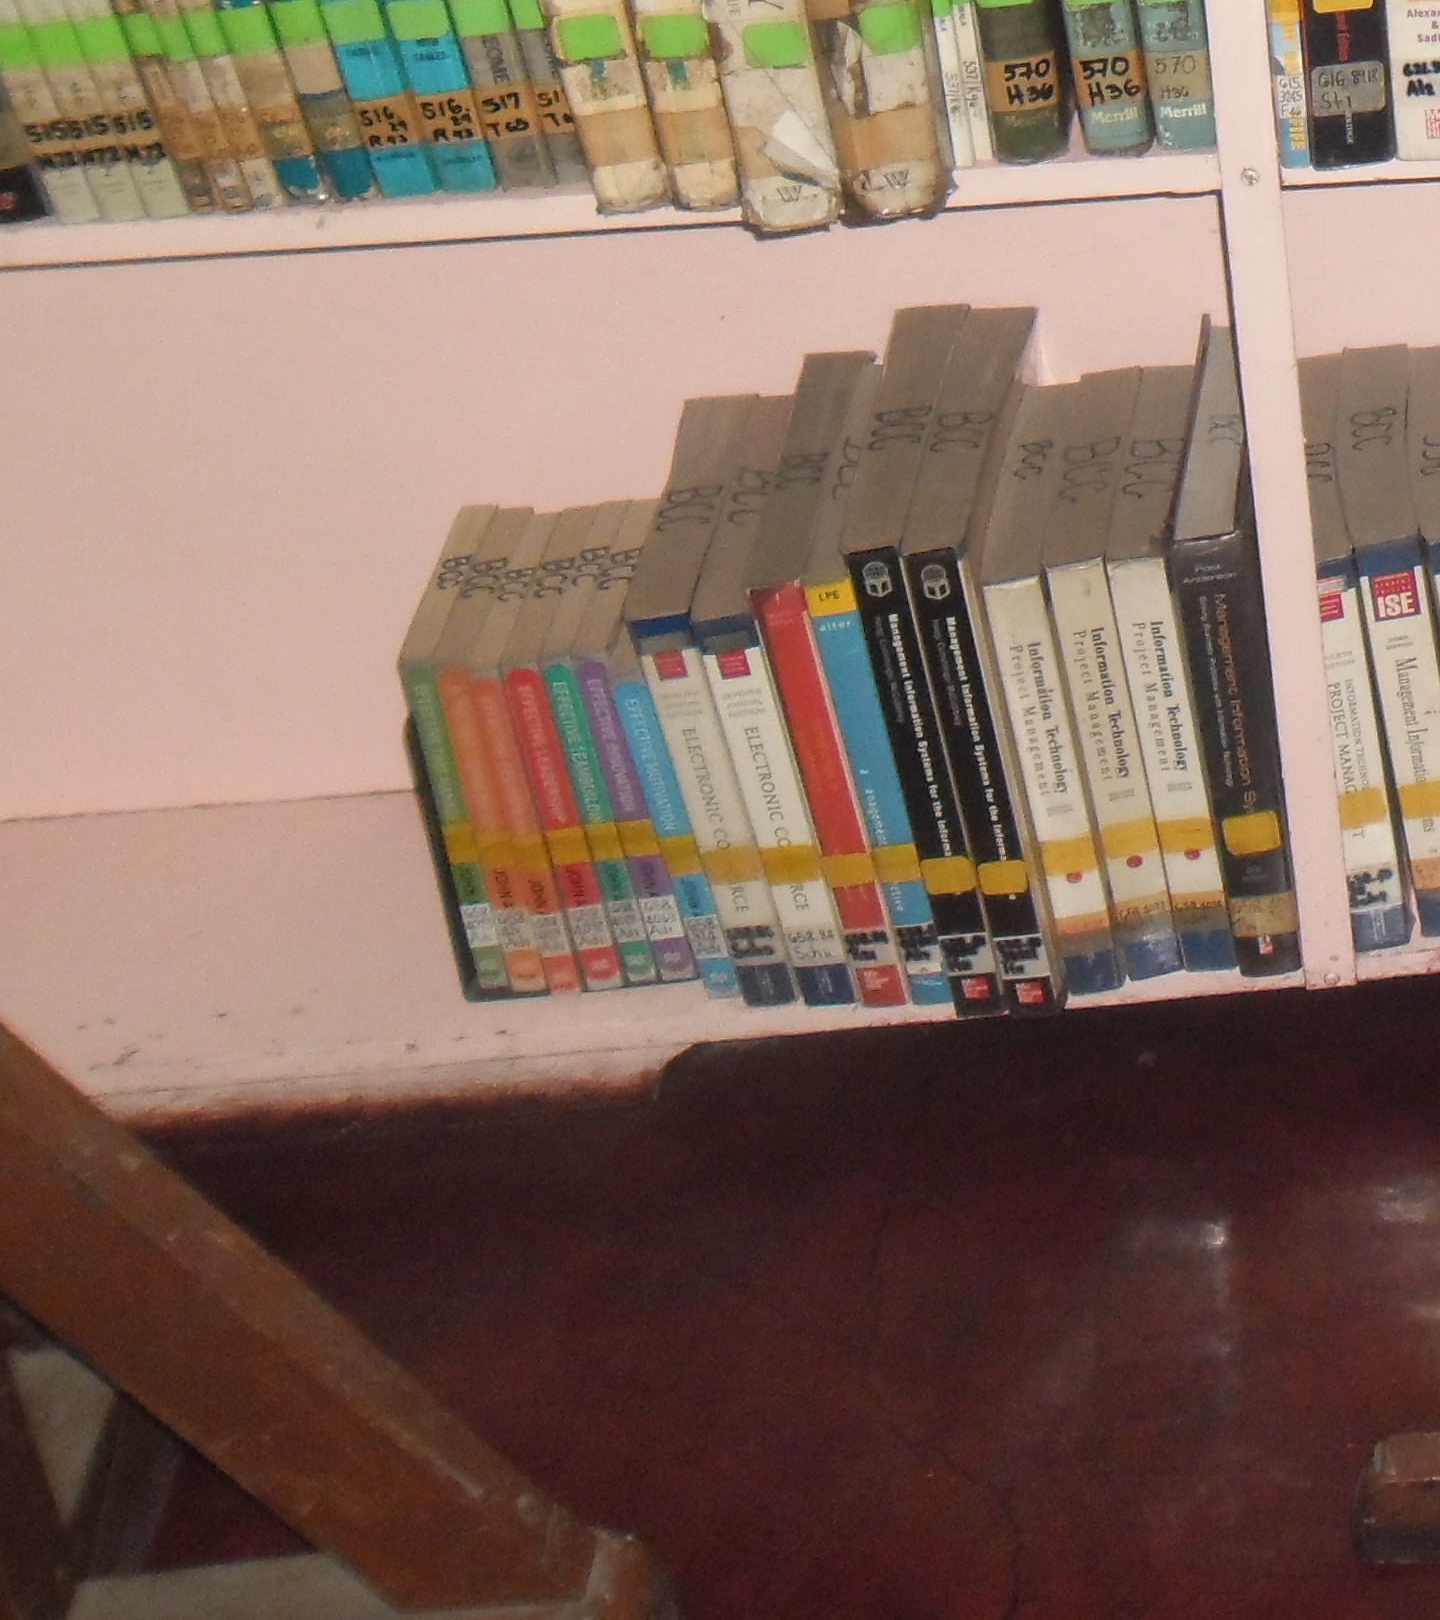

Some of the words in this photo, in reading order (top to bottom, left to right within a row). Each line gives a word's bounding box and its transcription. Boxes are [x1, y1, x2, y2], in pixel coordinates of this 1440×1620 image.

[1004, 58, 1051, 82] 570
[1079, 57, 1129, 80] 570
[1155, 55, 1196, 76] 570
[1092, 107, 1139, 125] Merrill
[1160, 103, 1207, 120] Merrill
[1378, 591, 1416, 618] ISE
[1091, 627, 1116, 705] Information
[1108, 709, 1130, 778] Technology
[1150, 620, 1174, 698] Information
[1167, 702, 1188, 772] Technology
[1027, 641, 1053, 721] Information
[1045, 725, 1068, 794] Technology
[682, 727, 724, 824] ELECTRONIC
[744, 726, 785, 822] ELECTRONIC
